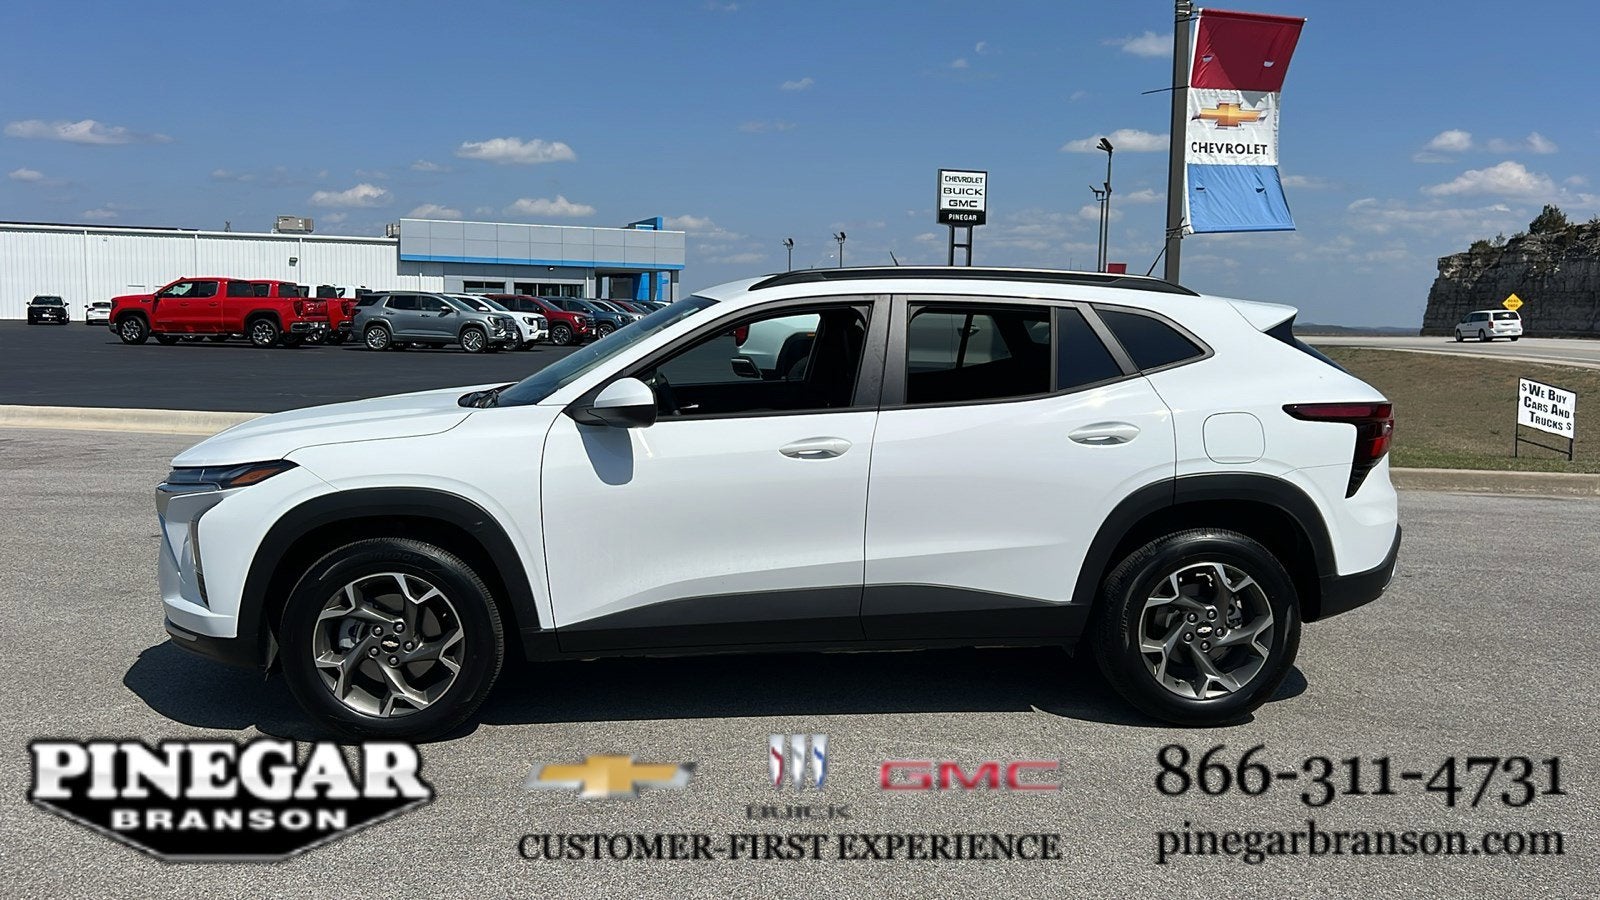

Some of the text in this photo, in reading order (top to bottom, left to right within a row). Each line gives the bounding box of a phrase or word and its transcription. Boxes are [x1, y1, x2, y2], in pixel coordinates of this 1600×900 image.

[1191, 142, 1268, 155] CHEVROLET
[944, 175, 983, 183] CHEVROLET
[943, 187, 983, 196] BUICK
[948, 199, 978, 208] GMC
[948, 213, 977, 221] PINEGAR
